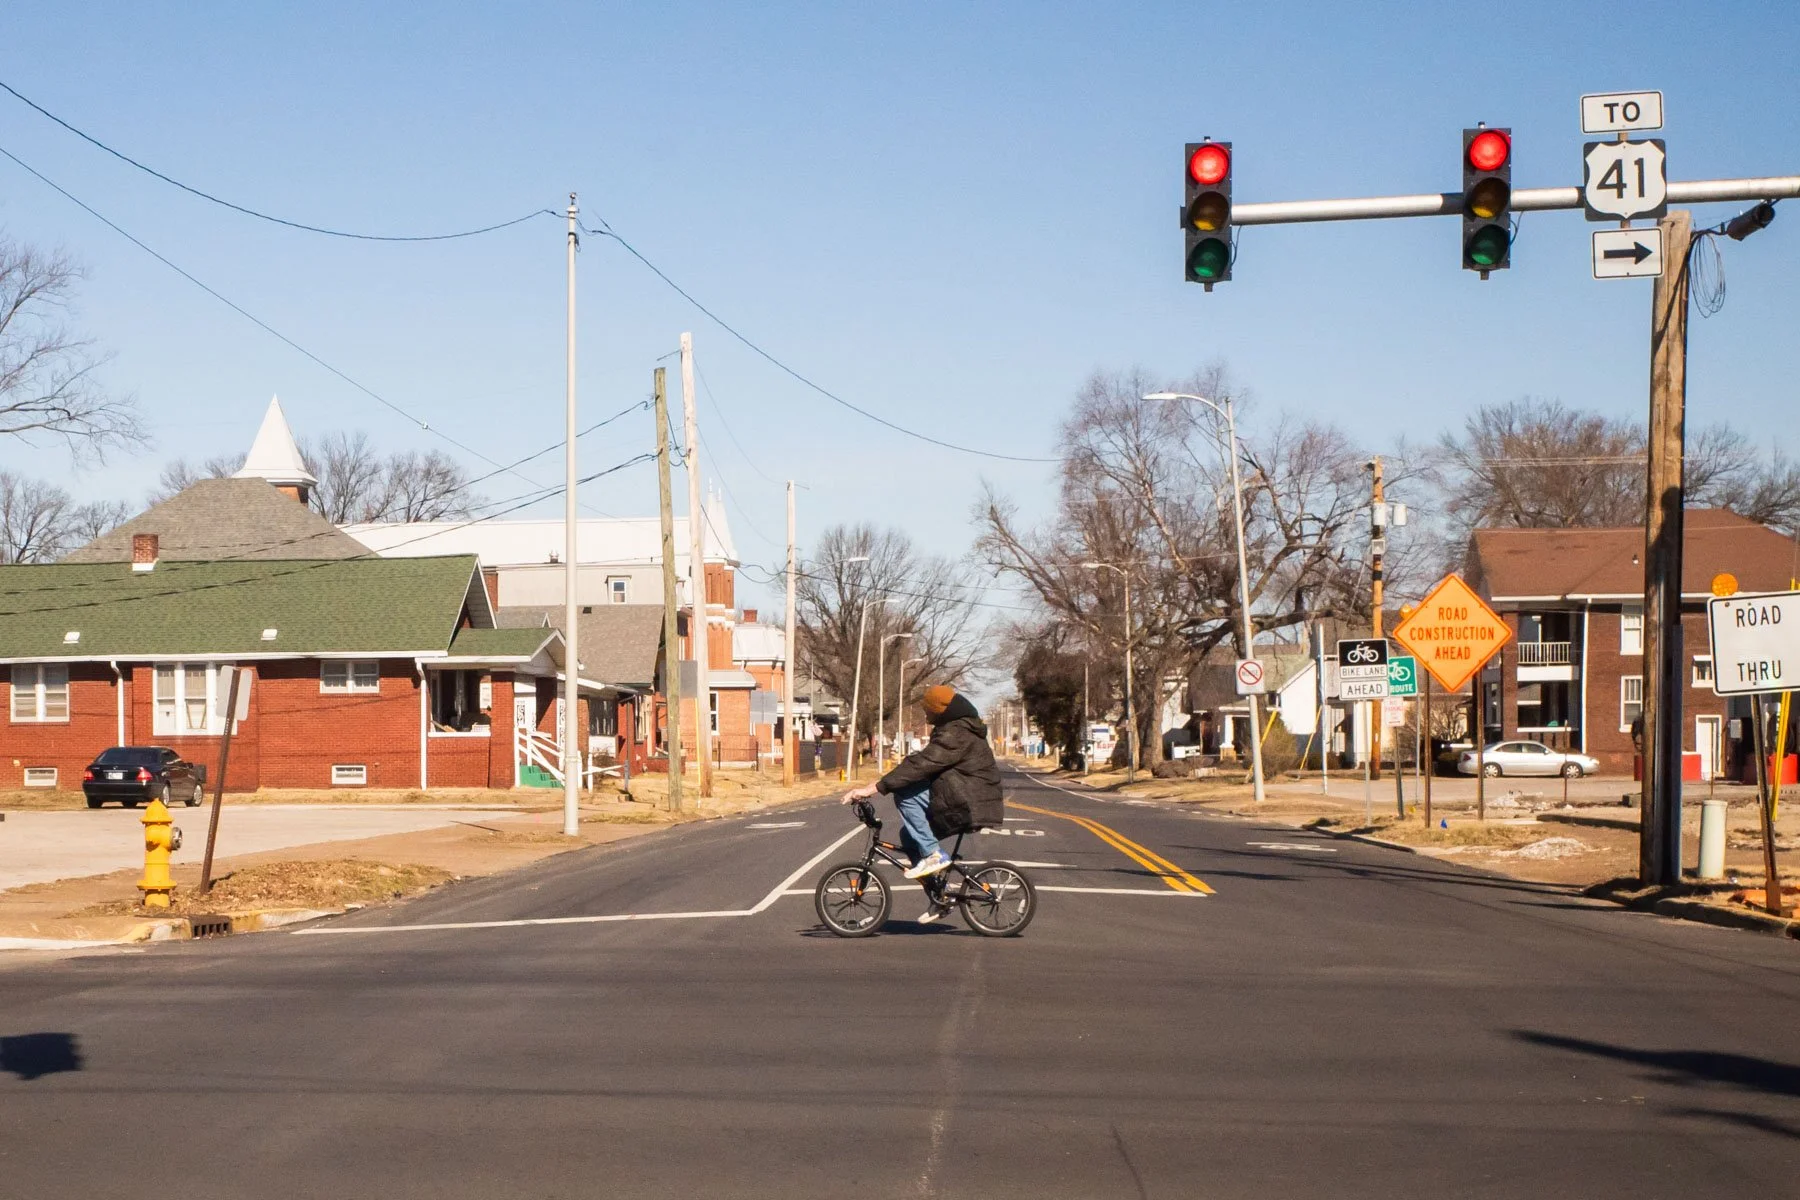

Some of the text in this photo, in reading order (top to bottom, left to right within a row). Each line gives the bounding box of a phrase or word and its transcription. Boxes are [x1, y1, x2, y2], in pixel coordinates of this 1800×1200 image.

[1604, 101, 1640, 123] TO
[1597, 157, 1644, 199] 41
[1438, 607, 1468, 620] ROAD
[1736, 605, 1781, 627] ROAD
[1409, 626, 1495, 641] CONSTRUCTION
[1434, 646, 1471, 660] AHEAD
[1342, 666, 1385, 677] BIKE LANE
[1737, 660, 1781, 681] THRU
[1347, 684, 1383, 696] AHEAD
[1390, 684, 1414, 693] ROUTE
